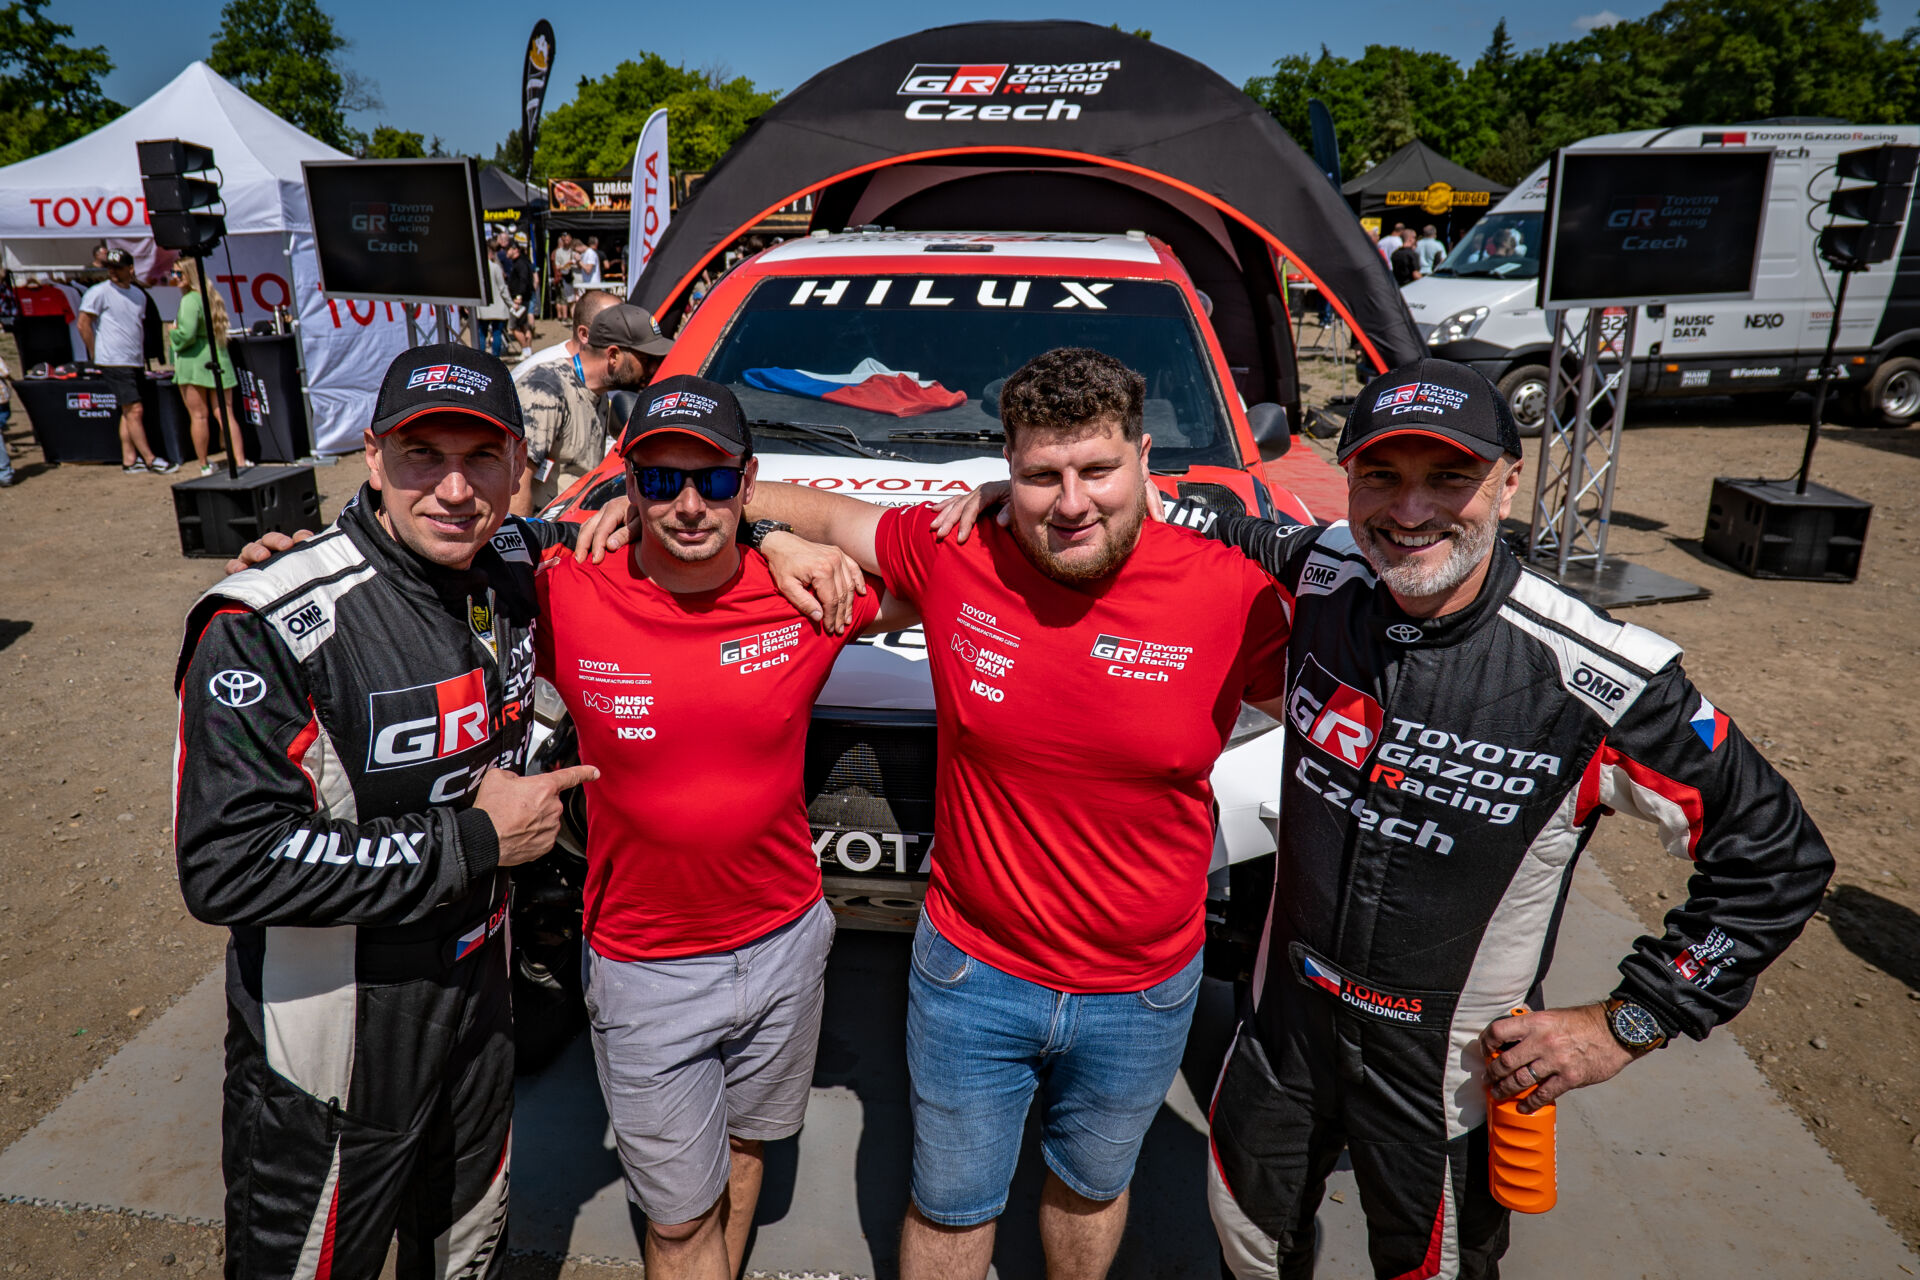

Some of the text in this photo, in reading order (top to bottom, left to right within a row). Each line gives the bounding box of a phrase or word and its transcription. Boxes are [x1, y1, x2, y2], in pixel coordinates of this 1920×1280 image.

[1014, 60, 1121, 75] TOYOTA
[904, 75, 997, 93] GR
[1007, 71, 1109, 85] GAZOO
[1002, 82, 1104, 96] Racing
[904, 98, 1082, 121] Czech
[1774, 146, 1810, 160] ech
[351, 214, 387, 231] GR
[1607, 208, 1657, 227] GR
[1667, 218, 1708, 229] acing
[398, 224, 430, 235] acing
[367, 238, 419, 253] Czech
[1622, 234, 1688, 250] Czech
[789, 280, 1114, 309] HILUX
[1674, 315, 1715, 326] MUSIC
[1744, 313, 1785, 329] NEXO
[1672, 327, 1707, 338] DATA
[410, 370, 445, 385] GR
[449, 370, 489, 387] GAZOO
[452, 365, 493, 383] TOYOTA
[426, 382, 475, 396] Czech
[447, 375, 487, 392] Racing
[1421, 383, 1469, 399] TOYOTA
[68, 398, 90, 409] GR
[681, 397, 715, 410] GAZOO
[683, 392, 719, 407] TOYOTA
[1377, 390, 1414, 407] GR
[1416, 395, 1461, 410] Racing
[1420, 389, 1463, 403] GAZOO
[651, 397, 677, 412] GR
[679, 401, 713, 415] Racing
[1392, 405, 1444, 415] Czech
[78, 409, 111, 418] Czech
[660, 409, 701, 418] Czech
[782, 478, 973, 492] TOYOTA
[493, 534, 522, 551] OMP
[1303, 565, 1337, 586] OMP
[287, 604, 323, 635] OMP
[962, 602, 997, 625] TOYOTA
[761, 622, 802, 639] TOYOTA
[762, 630, 799, 647] GAZOO
[722, 643, 759, 663] GR
[762, 638, 799, 654] Racing
[1093, 643, 1138, 662] GR
[1144, 642, 1194, 653] TOYOTA
[740, 652, 790, 675] Czech
[979, 647, 1015, 669] MUSIC
[1139, 656, 1185, 670] Racing
[1141, 650, 1188, 661] GAZOO
[578, 659, 621, 672] TOYOTA
[975, 657, 1006, 678] DATA
[1107, 665, 1169, 682] Czech
[970, 679, 1005, 703] NEXO
[1572, 667, 1625, 703] OMP
[614, 695, 655, 706] MUSIC
[614, 705, 650, 716] DATA
[374, 701, 487, 764] GR
[1290, 685, 1375, 764] GR
[617, 726, 657, 741] NEXO
[1391, 717, 1561, 776] TOYOTA
[1377, 742, 1536, 797] GAZOO
[1369, 763, 1521, 825] Racing
[1295, 756, 1455, 856] Czech
[269, 828, 426, 868] HILUX
[1693, 931, 1727, 961] GAZOO
[1343, 977, 1423, 1012] TOMAS
[1341, 992, 1422, 1022] OUREDNICEK
